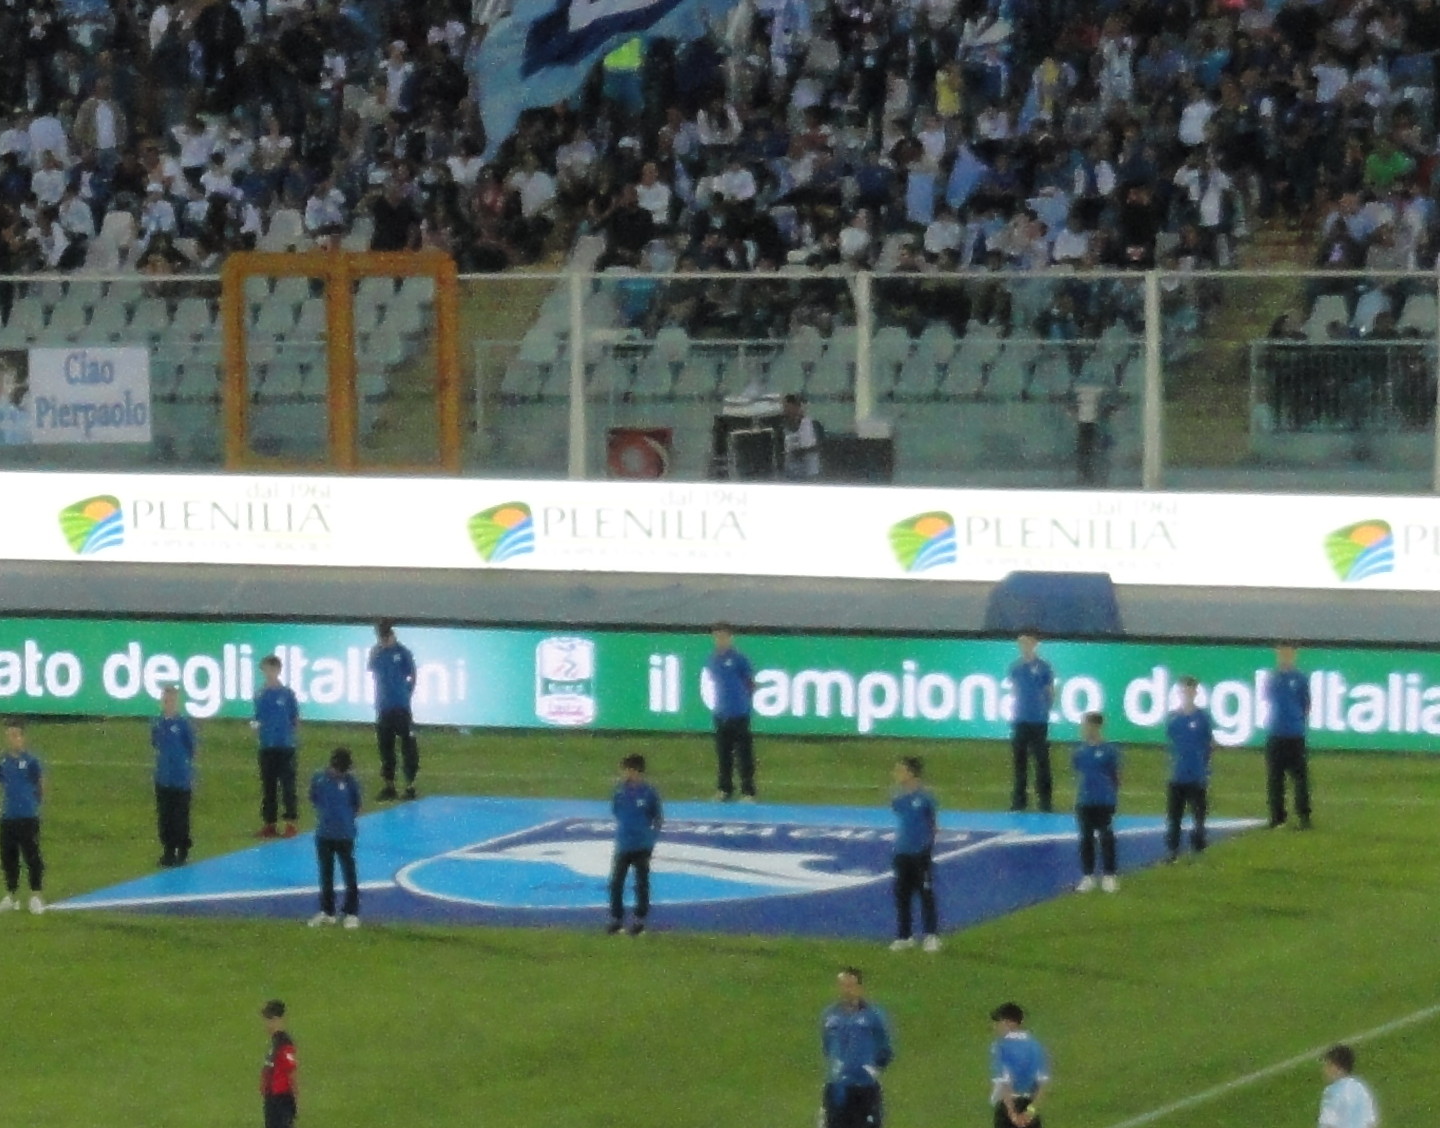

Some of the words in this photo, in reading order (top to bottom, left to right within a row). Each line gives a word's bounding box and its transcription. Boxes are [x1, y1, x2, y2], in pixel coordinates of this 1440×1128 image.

[63, 350, 115, 385] Ciao
[34, 390, 148, 438] Pierpaolo
[132, 499, 332, 533] PLENILIA
[542, 506, 748, 541] PLENILIA
[964, 515, 1178, 550] PLENILIA
[102, 641, 254, 718] degli
[648, 653, 681, 713] il
[700, 659, 1104, 734] ampiono
